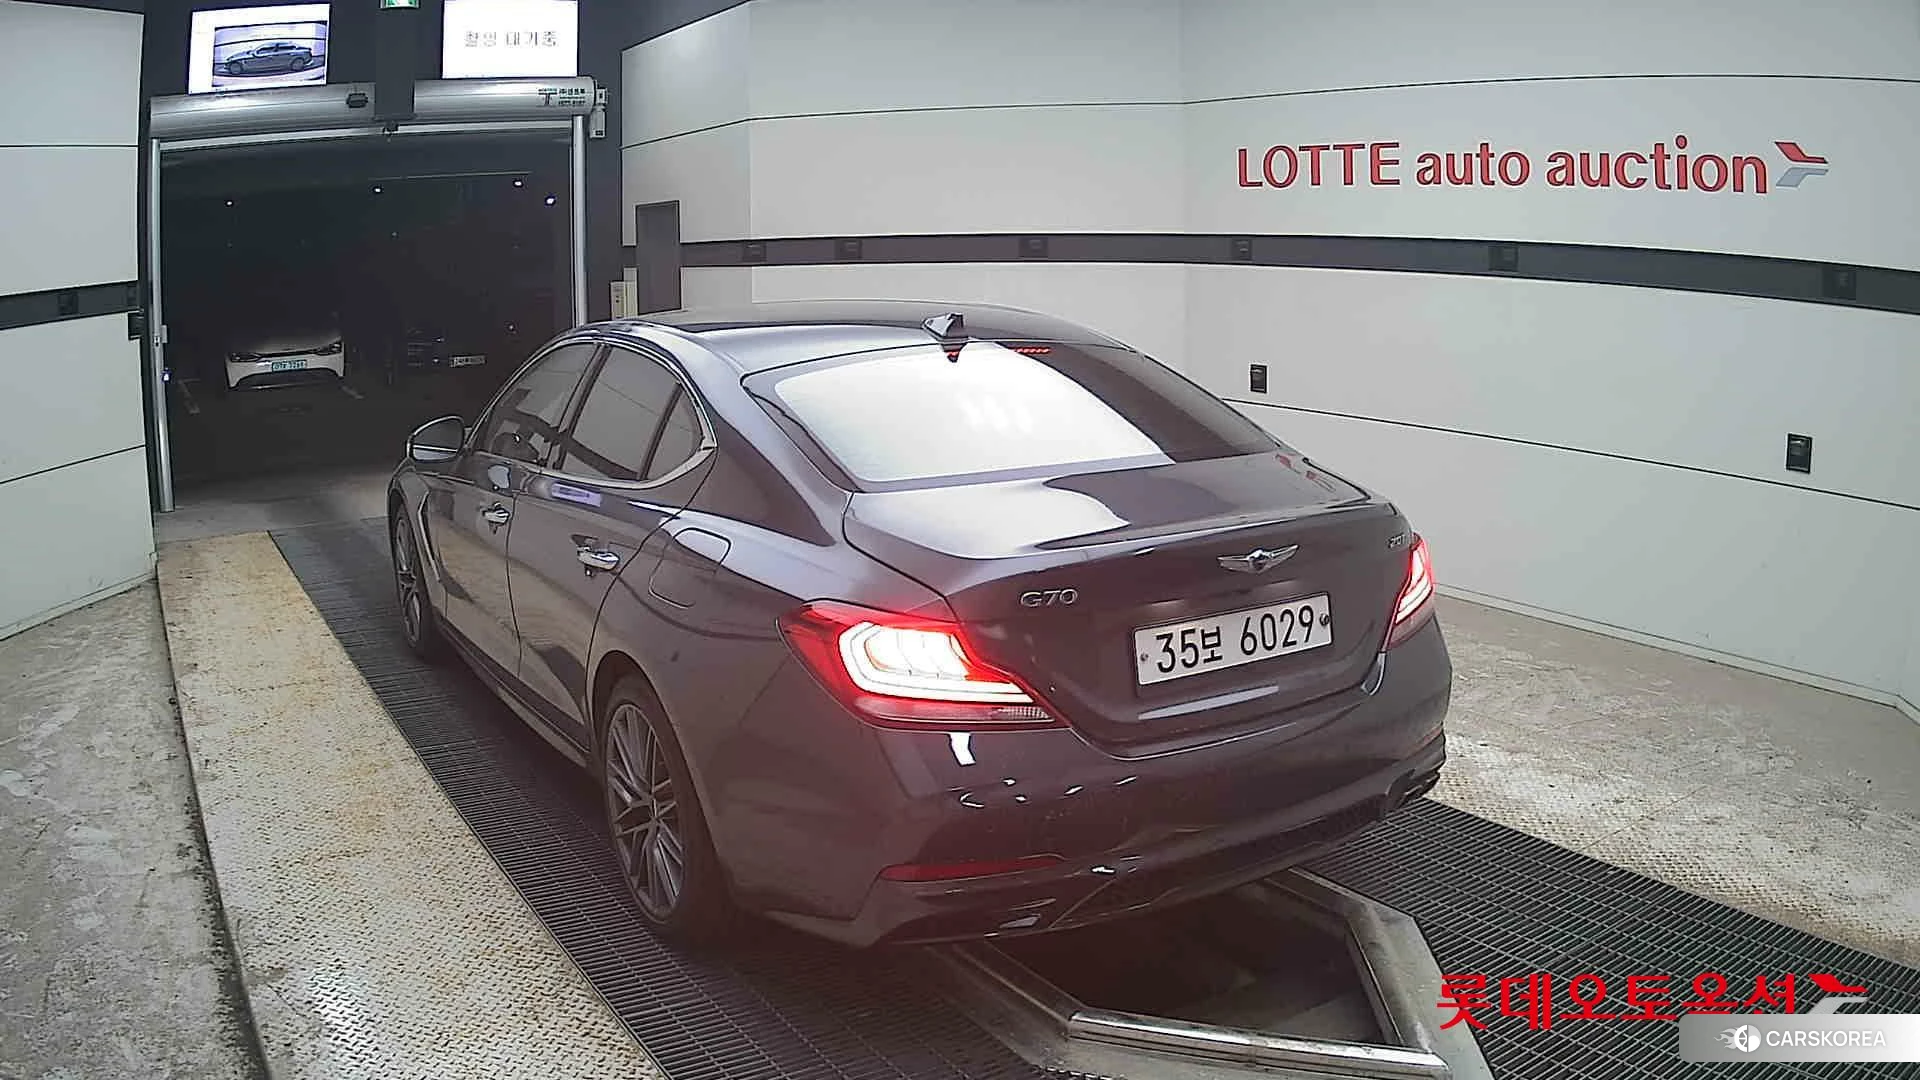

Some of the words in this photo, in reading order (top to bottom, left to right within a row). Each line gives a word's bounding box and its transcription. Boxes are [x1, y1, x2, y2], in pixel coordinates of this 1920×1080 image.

[1237, 142, 1400, 189] LOTTE
[1416, 143, 1531, 187] auto
[1546, 134, 1768, 194] auction
[1020, 588, 1078, 607] G70
[1155, 625, 1223, 673] 35보
[1240, 605, 1314, 656] 6029
